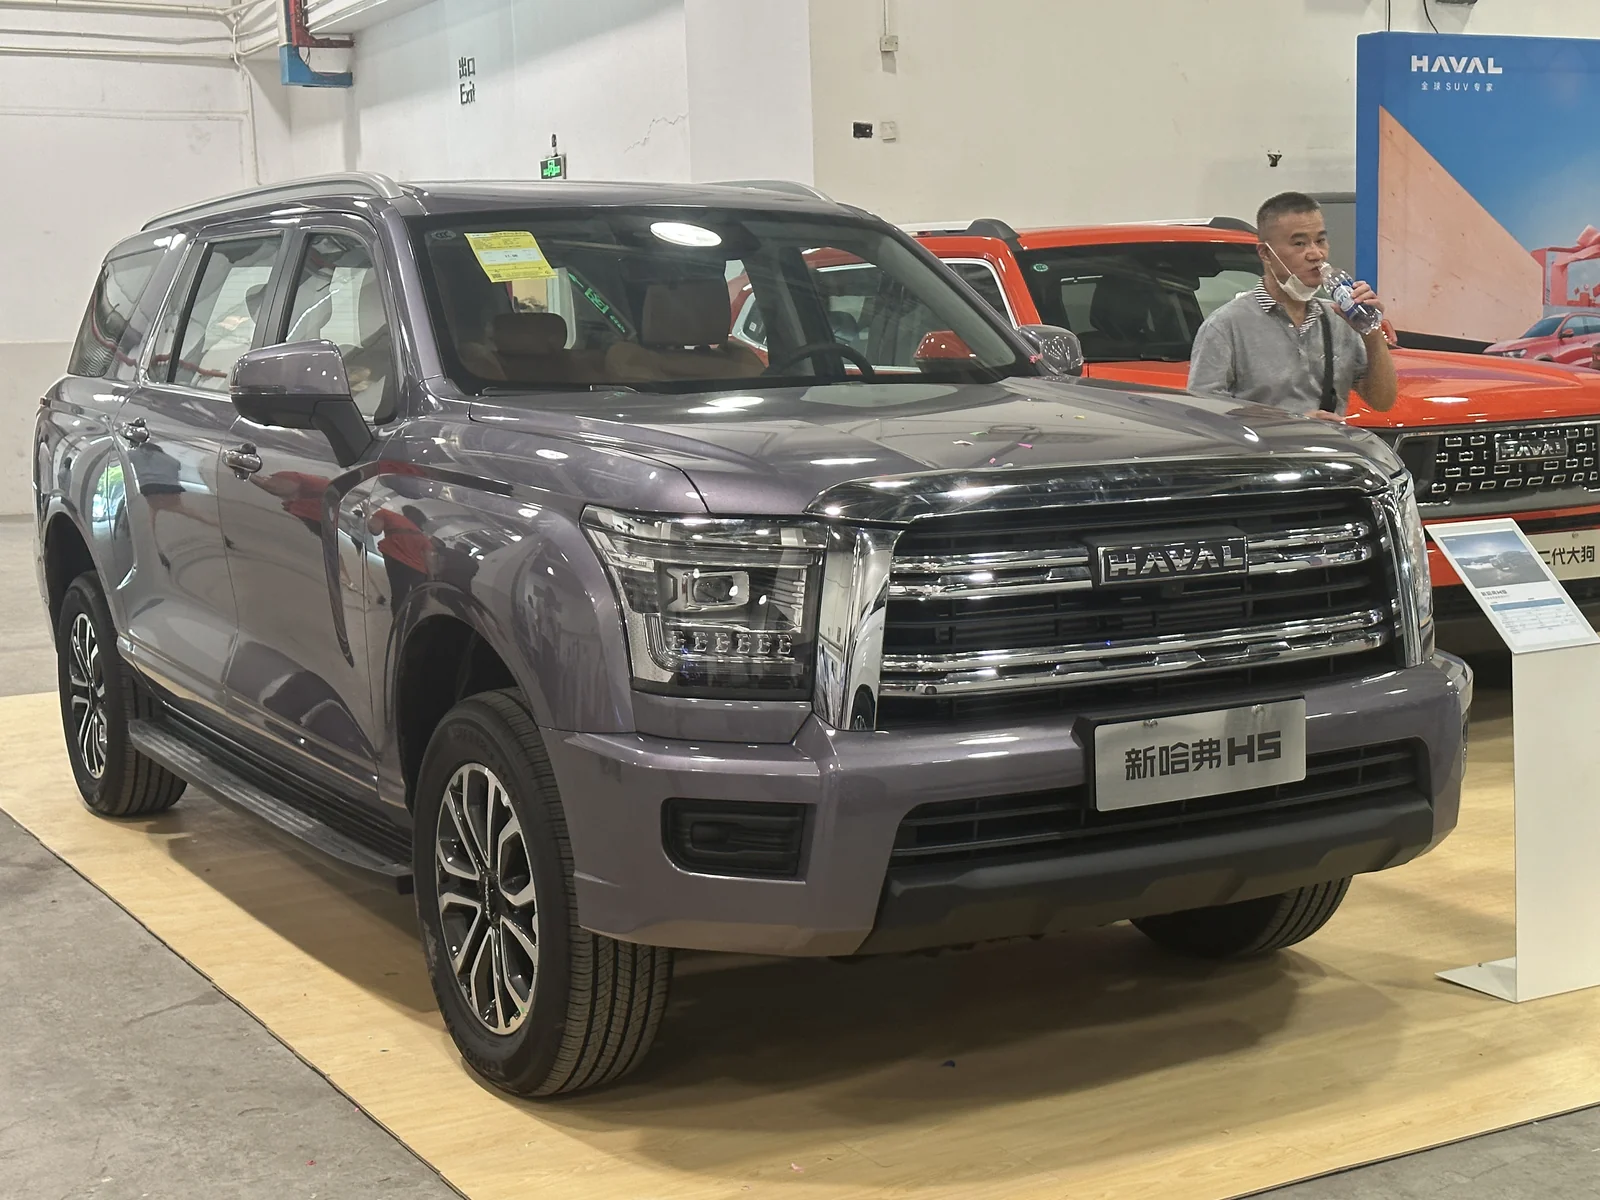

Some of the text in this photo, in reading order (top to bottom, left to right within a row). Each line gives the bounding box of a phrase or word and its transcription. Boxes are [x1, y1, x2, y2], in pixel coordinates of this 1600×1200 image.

[458, 56, 476, 79] 出口
[1411, 55, 1503, 74] HAVAL
[460, 81, 476, 104] Exit
[1421, 81, 1494, 92] 全球SUV专家
[1108, 545, 1244, 577] HAVAL
